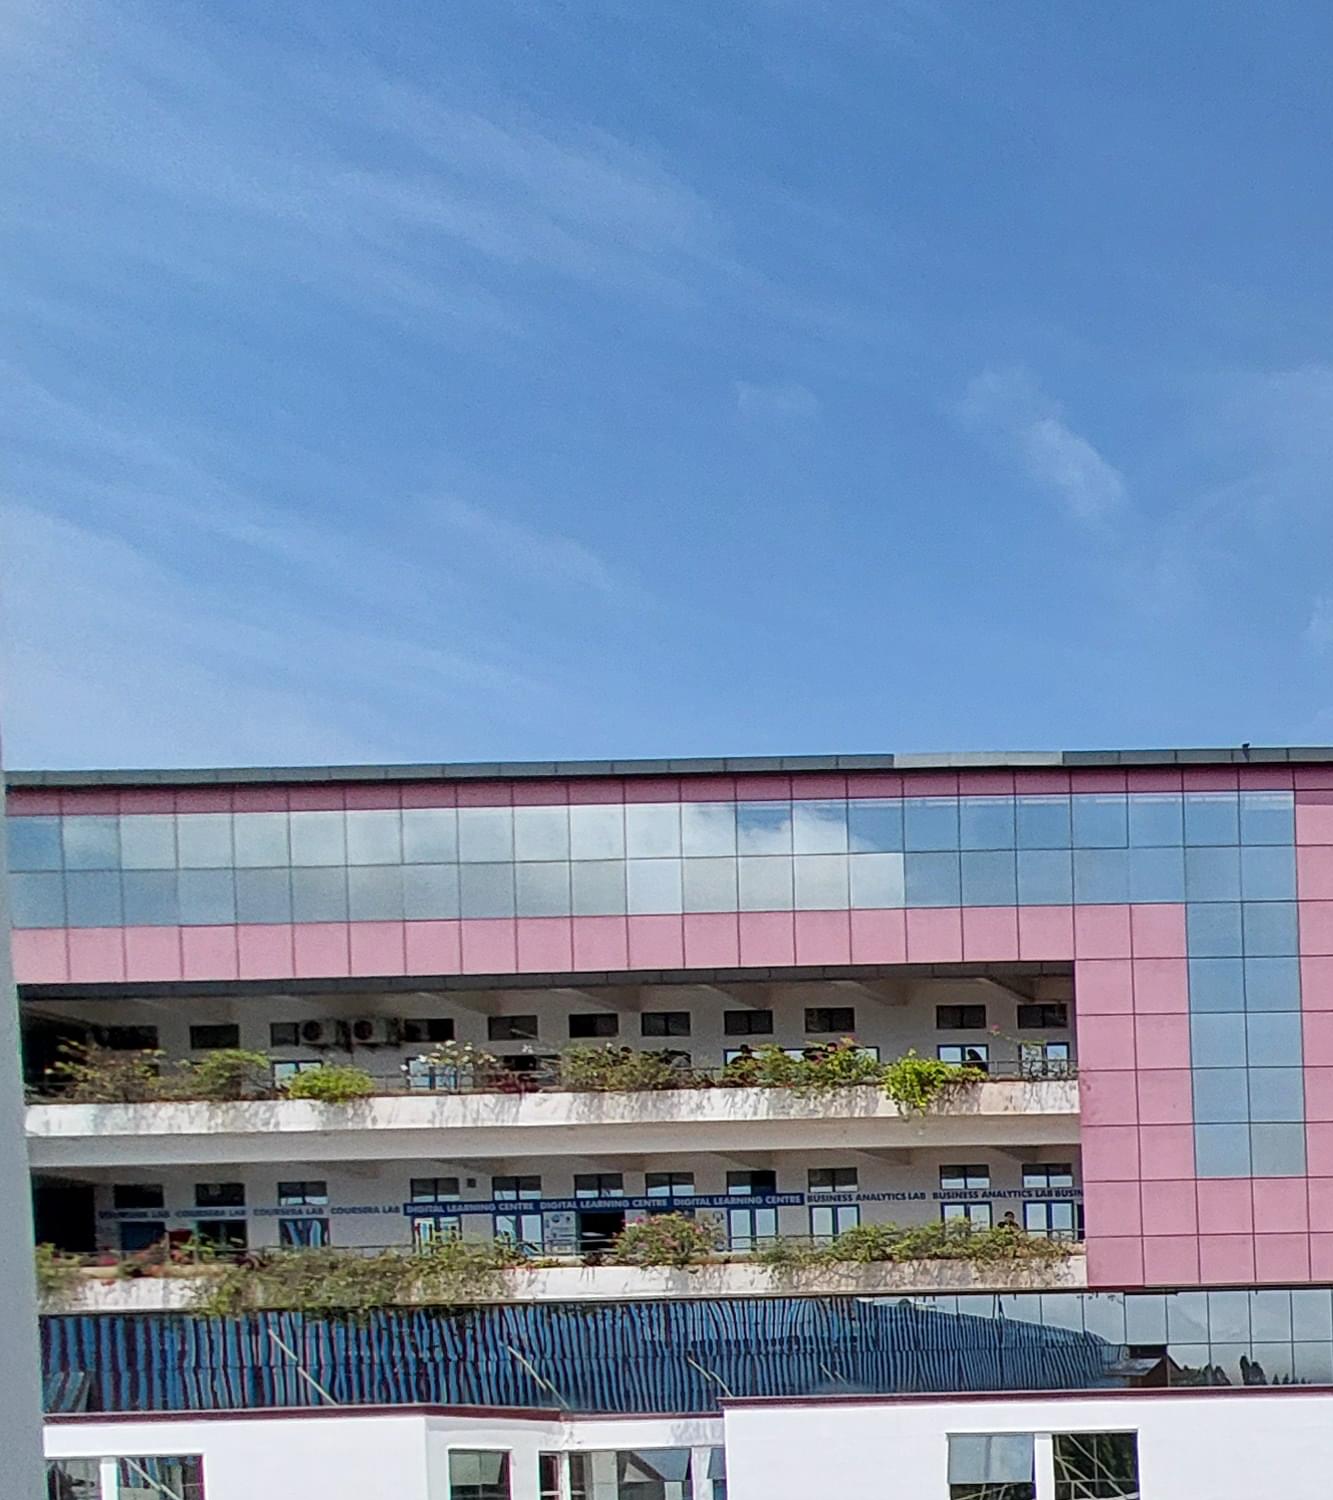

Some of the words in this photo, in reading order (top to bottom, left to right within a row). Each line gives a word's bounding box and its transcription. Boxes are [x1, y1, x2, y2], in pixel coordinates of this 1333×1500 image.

[807, 1193, 853, 1202] BUSINESS
[856, 1192, 906, 1201] ANALYTICS
[908, 1192, 927, 1200] LAB
[932, 1191, 979, 1200] BUSINESS
[982, 1190, 1032, 1199] ANALYTICS
[1035, 1189, 1053, 1198] LAB
[540, 1201, 577, 1210] DIGITAL
[580, 1199, 630, 1208] LEARNING
[632, 1198, 667, 1207] CENTRE
[673, 1197, 711, 1206] DIGITAL
[714, 1196, 763, 1206] LEARNING
[765, 1195, 801, 1204] CENTRE
[253, 1208, 304, 1217] COURSERA
[306, 1207, 324, 1216] LAB
[330, 1206, 380, 1215] COURSERA
[382, 1205, 401, 1214] LAB
[405, 1204, 445, 1213] DIGITAL
[446, 1203, 495, 1212] LEARNING
[498, 1202, 534, 1211] CENTRE
